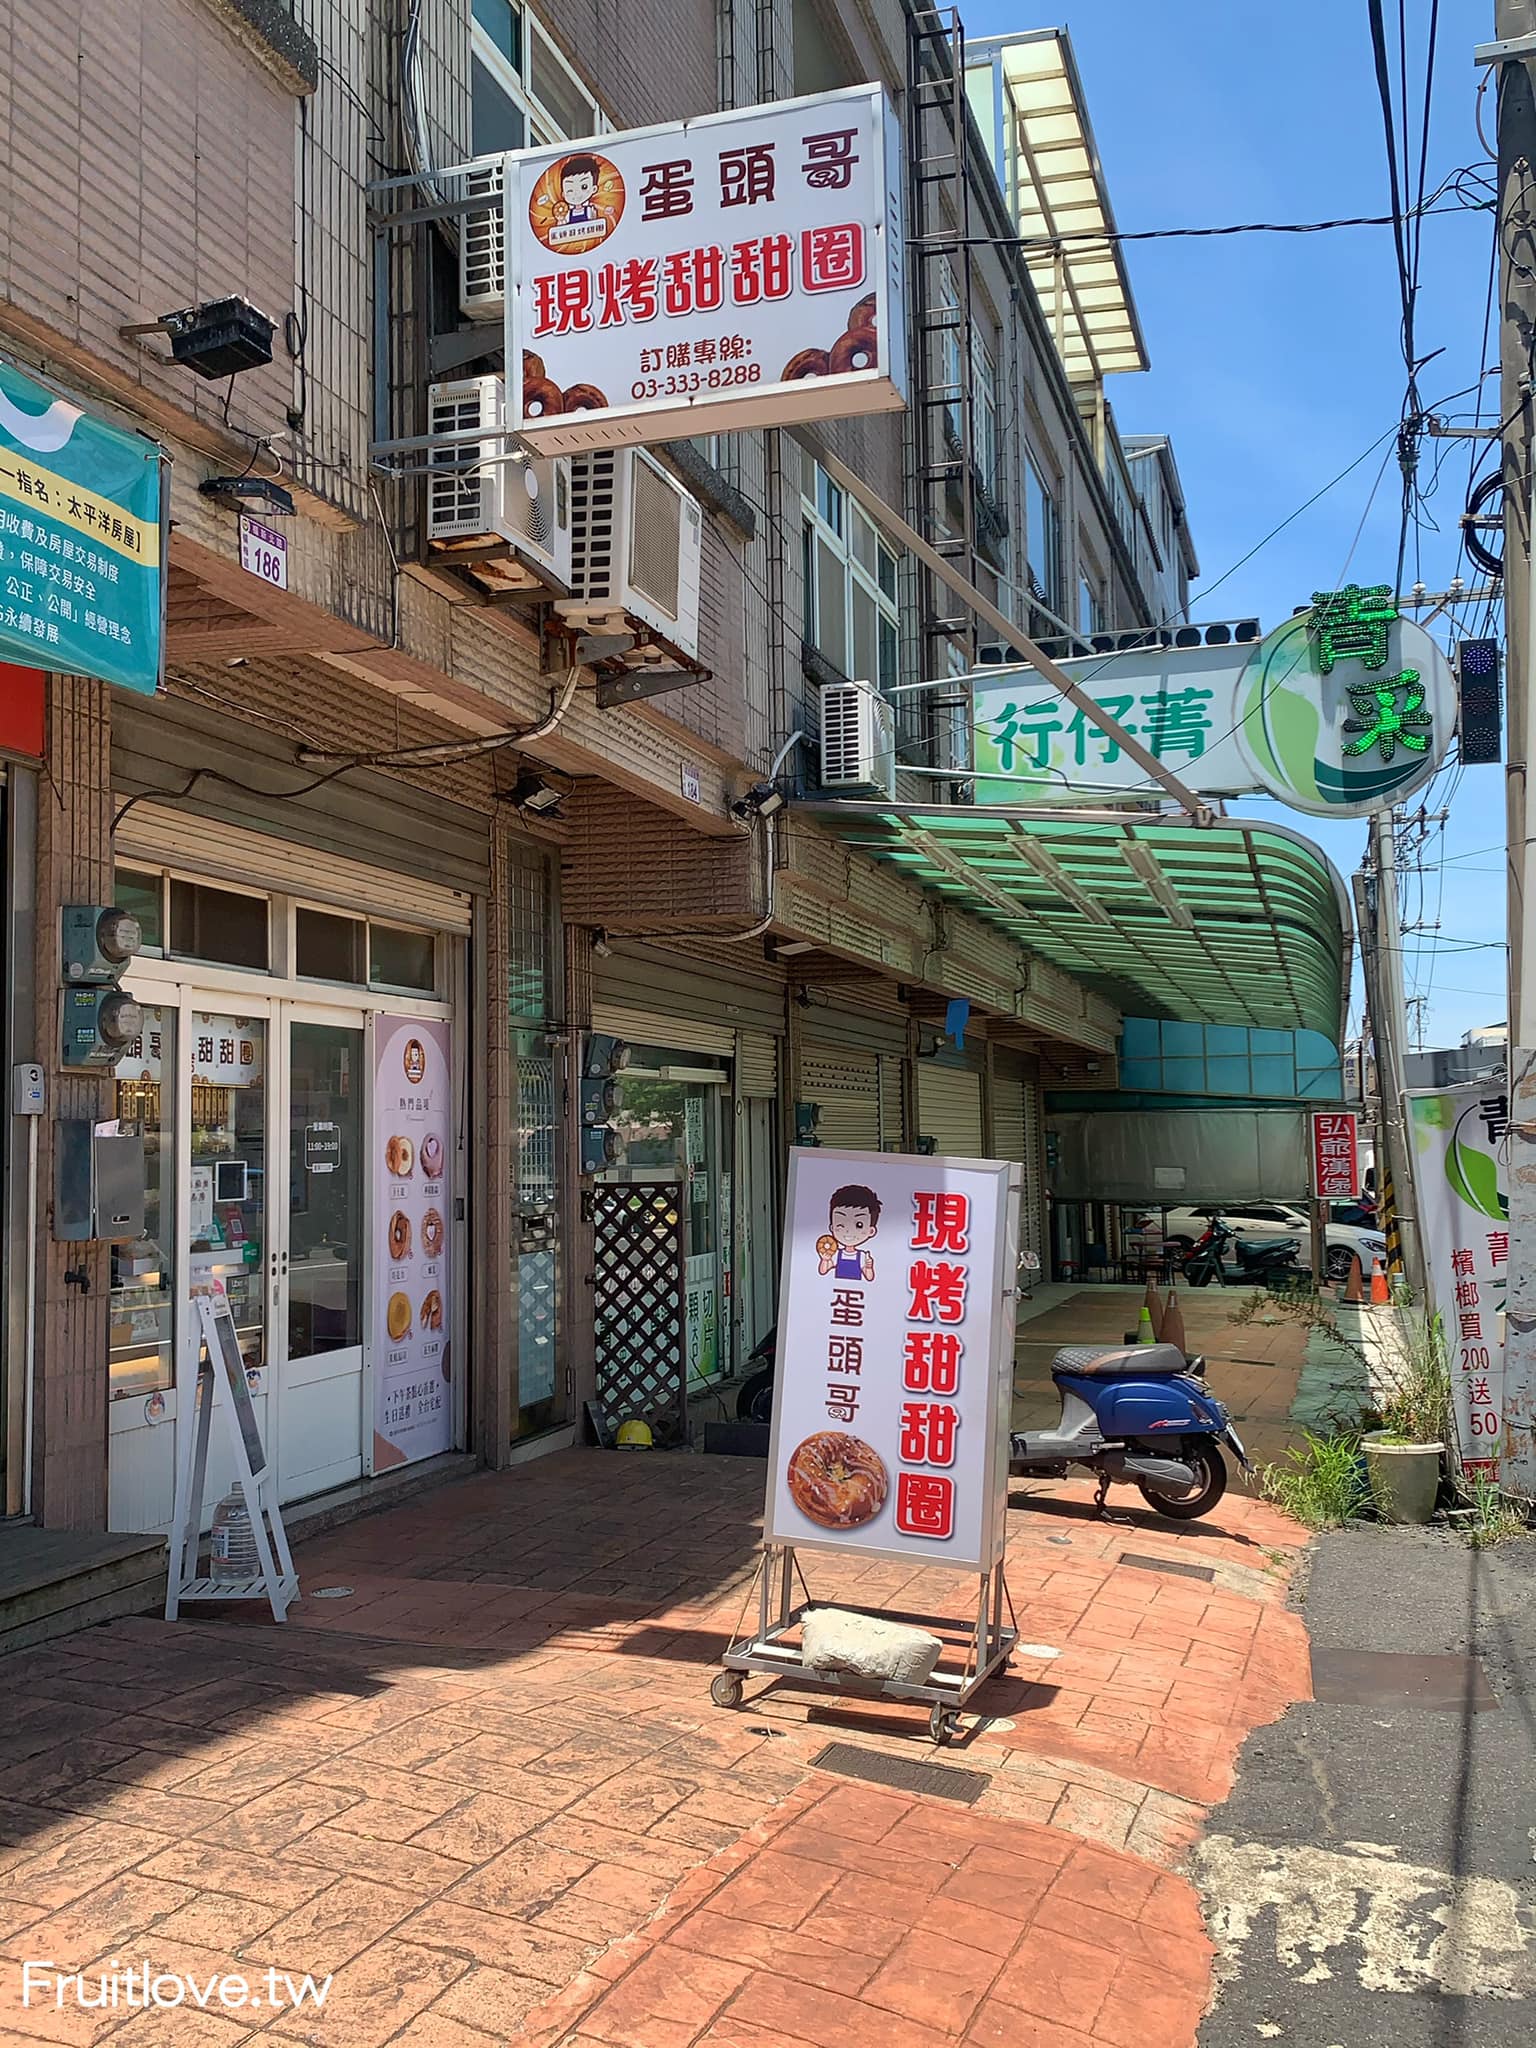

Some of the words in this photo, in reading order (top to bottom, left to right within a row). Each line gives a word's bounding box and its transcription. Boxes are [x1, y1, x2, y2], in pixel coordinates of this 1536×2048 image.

[639, 128, 859, 222] 蛋頭哥
[533, 223, 864, 336] 現烤甜甜圈
[631, 365, 761, 400] 03-333-8288
[255, 548, 280, 582] 186
[1320, 1118, 1352, 1195] 弘爺漢堡
[825, 1289, 865, 1422] 蛋頭哥
[896, 1192, 968, 1537] 現烤甜甜圈
